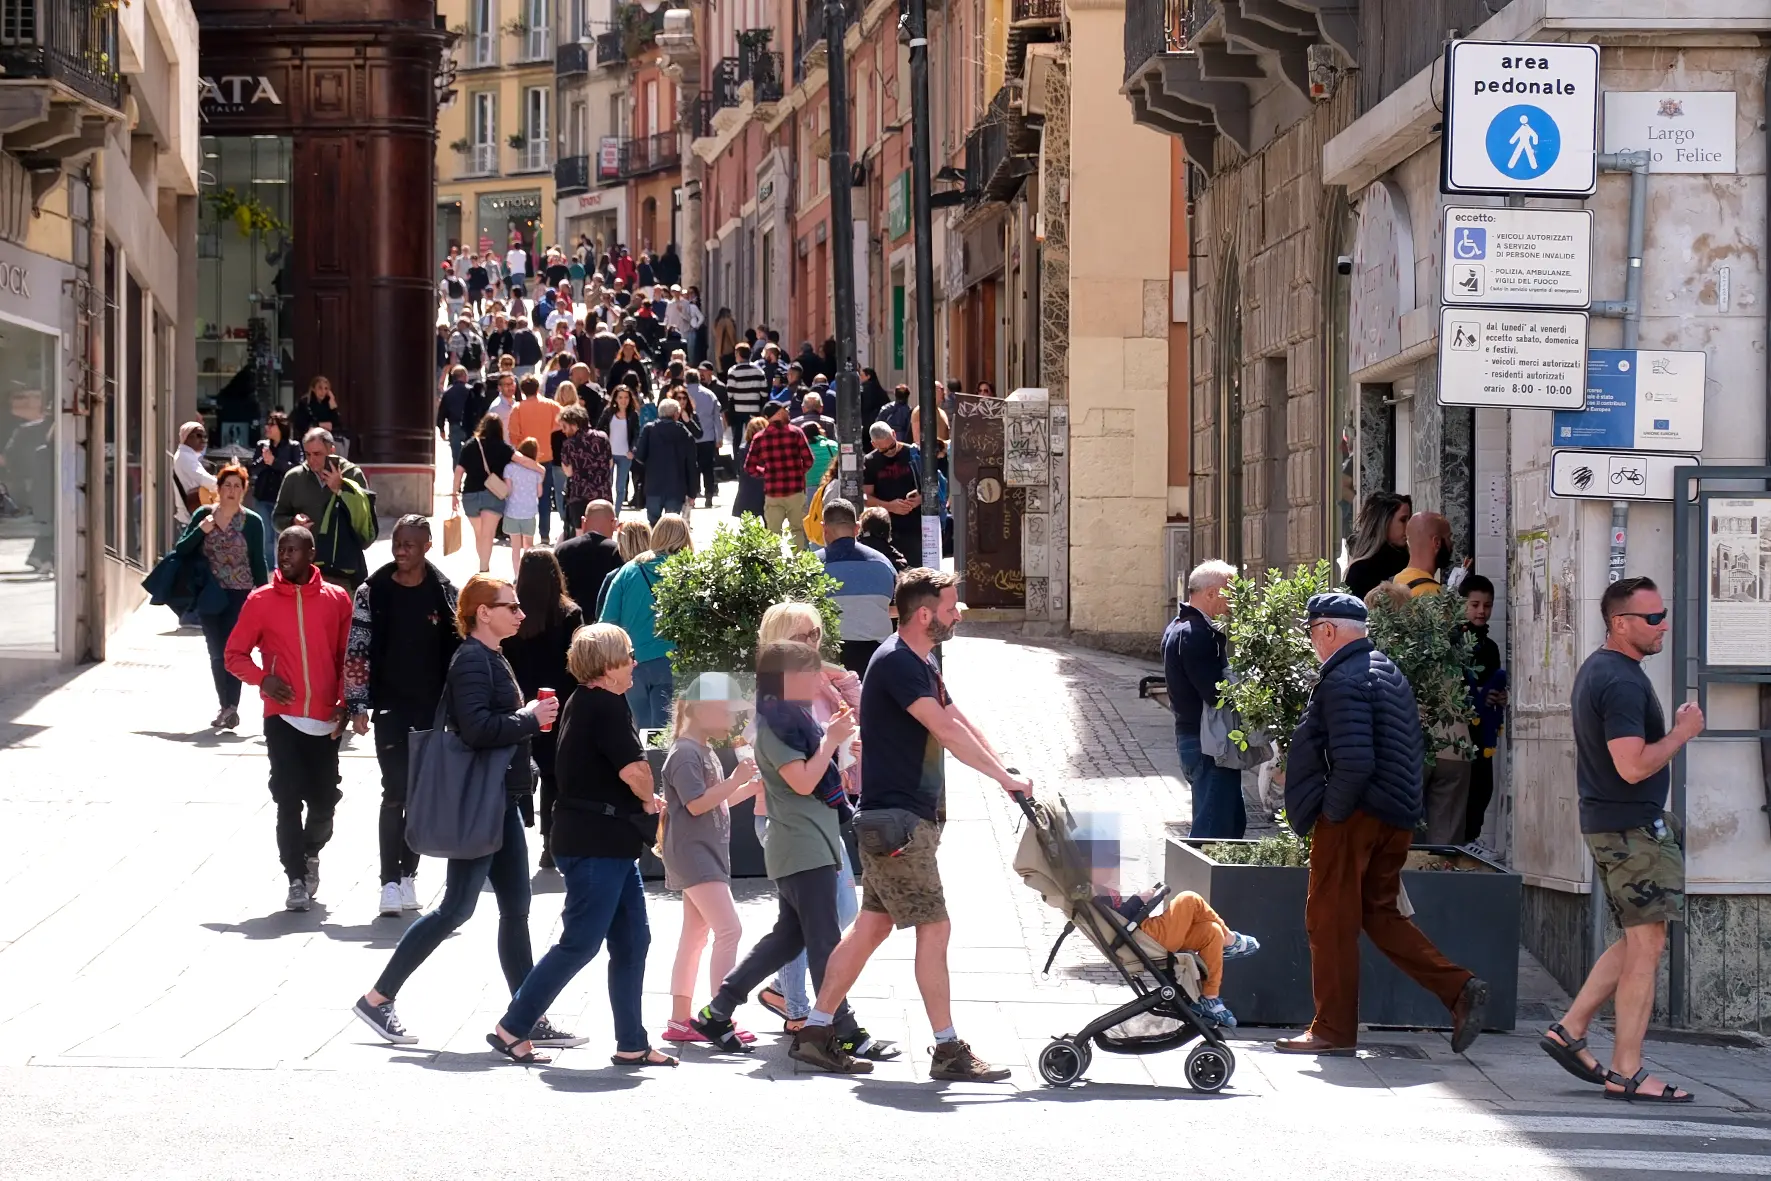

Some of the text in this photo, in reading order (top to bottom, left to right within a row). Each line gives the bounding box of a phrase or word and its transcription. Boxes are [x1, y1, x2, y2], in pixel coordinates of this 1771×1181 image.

[1502, 56, 1549, 70] area
[200, 76, 282, 104] ATA
[1474, 78, 1576, 96] pedonale
[1648, 126, 1694, 144] Largo
[1676, 148, 1722, 162] Felice
[1455, 213, 1496, 223] eccetto:
[0, 262, 31, 298] OCK
[1486, 322, 1498, 331] dal
[1540, 325, 1567, 334] venerdi
[1516, 335, 1542, 344] sabato,
[1545, 336, 1579, 345] domenica
[1493, 345, 1518, 354] festivi.
[1492, 357, 1516, 366] veicoli
[1519, 358, 1539, 366] merci
[1542, 360, 1581, 368] autorizzati
[1492, 370, 1524, 379] residenti
[1527, 372, 1565, 380] autorizzati
[1512, 384, 1533, 393] 8:00
[1546, 385, 1572, 395] 10:00
